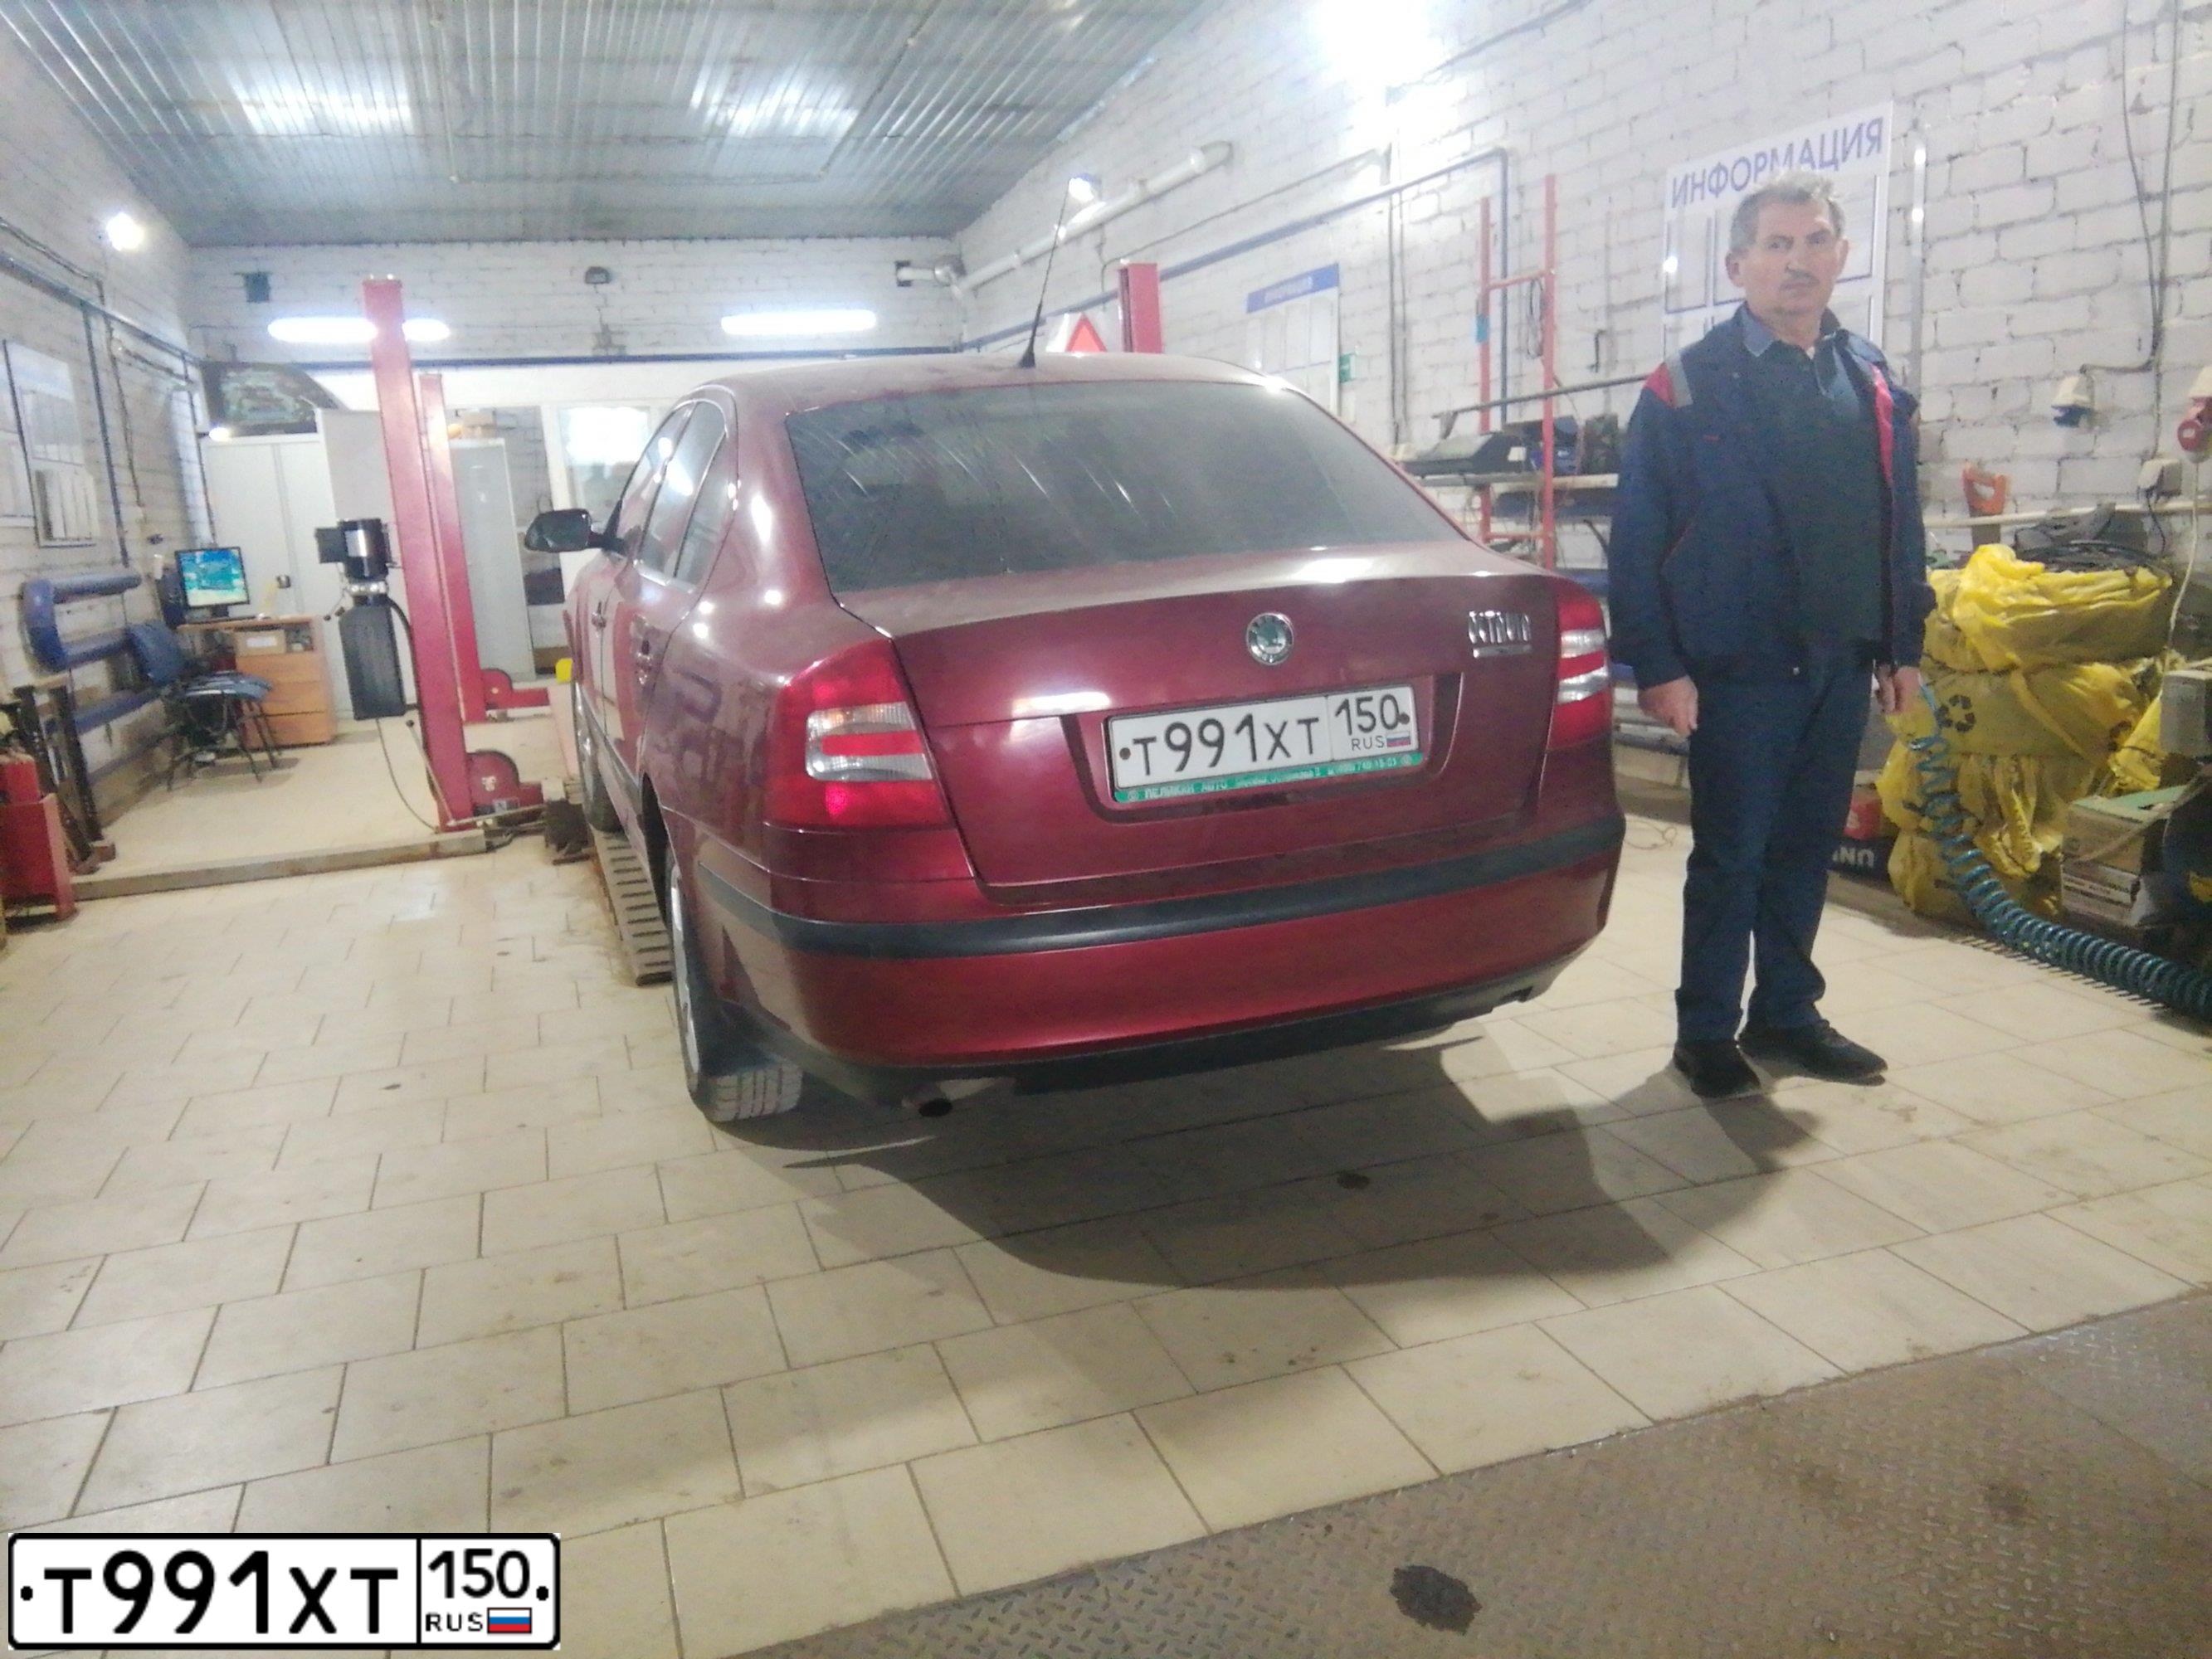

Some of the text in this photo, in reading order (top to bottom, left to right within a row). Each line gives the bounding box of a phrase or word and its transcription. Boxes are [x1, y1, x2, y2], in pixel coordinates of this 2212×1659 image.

[1670, 116, 1884, 209] ИНФОРМАЦИЯ
[1334, 693, 1401, 737] 150
[1352, 735, 1385, 752] RUS
